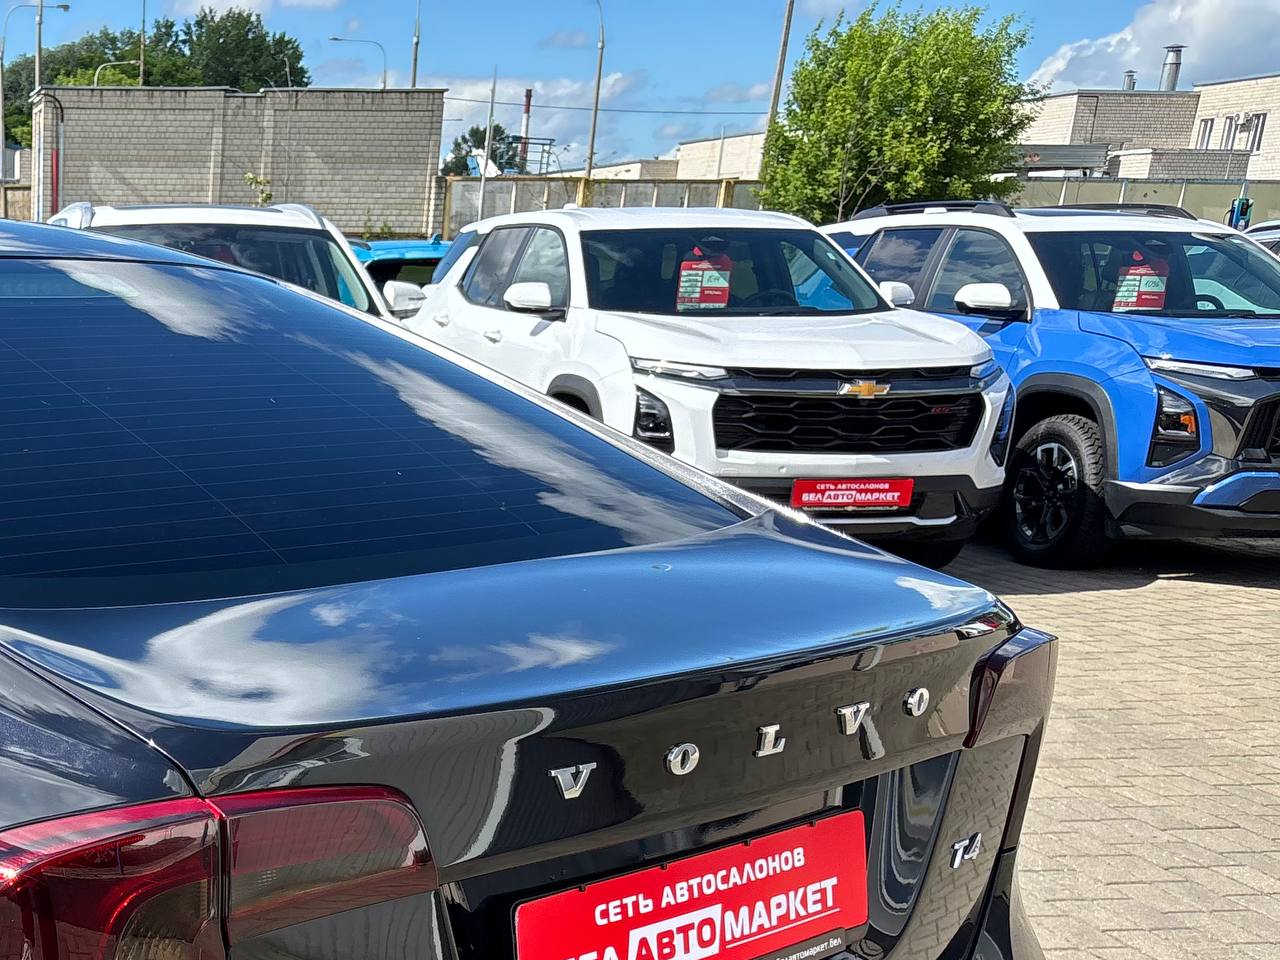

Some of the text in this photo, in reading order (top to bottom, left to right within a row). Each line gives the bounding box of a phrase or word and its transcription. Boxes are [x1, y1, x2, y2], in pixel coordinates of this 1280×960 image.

[547, 687, 929, 800] VOLVO
[594, 847, 805, 926] СЕТЬ АВТОСАЛОНОВ
[950, 832, 982, 869] T4
